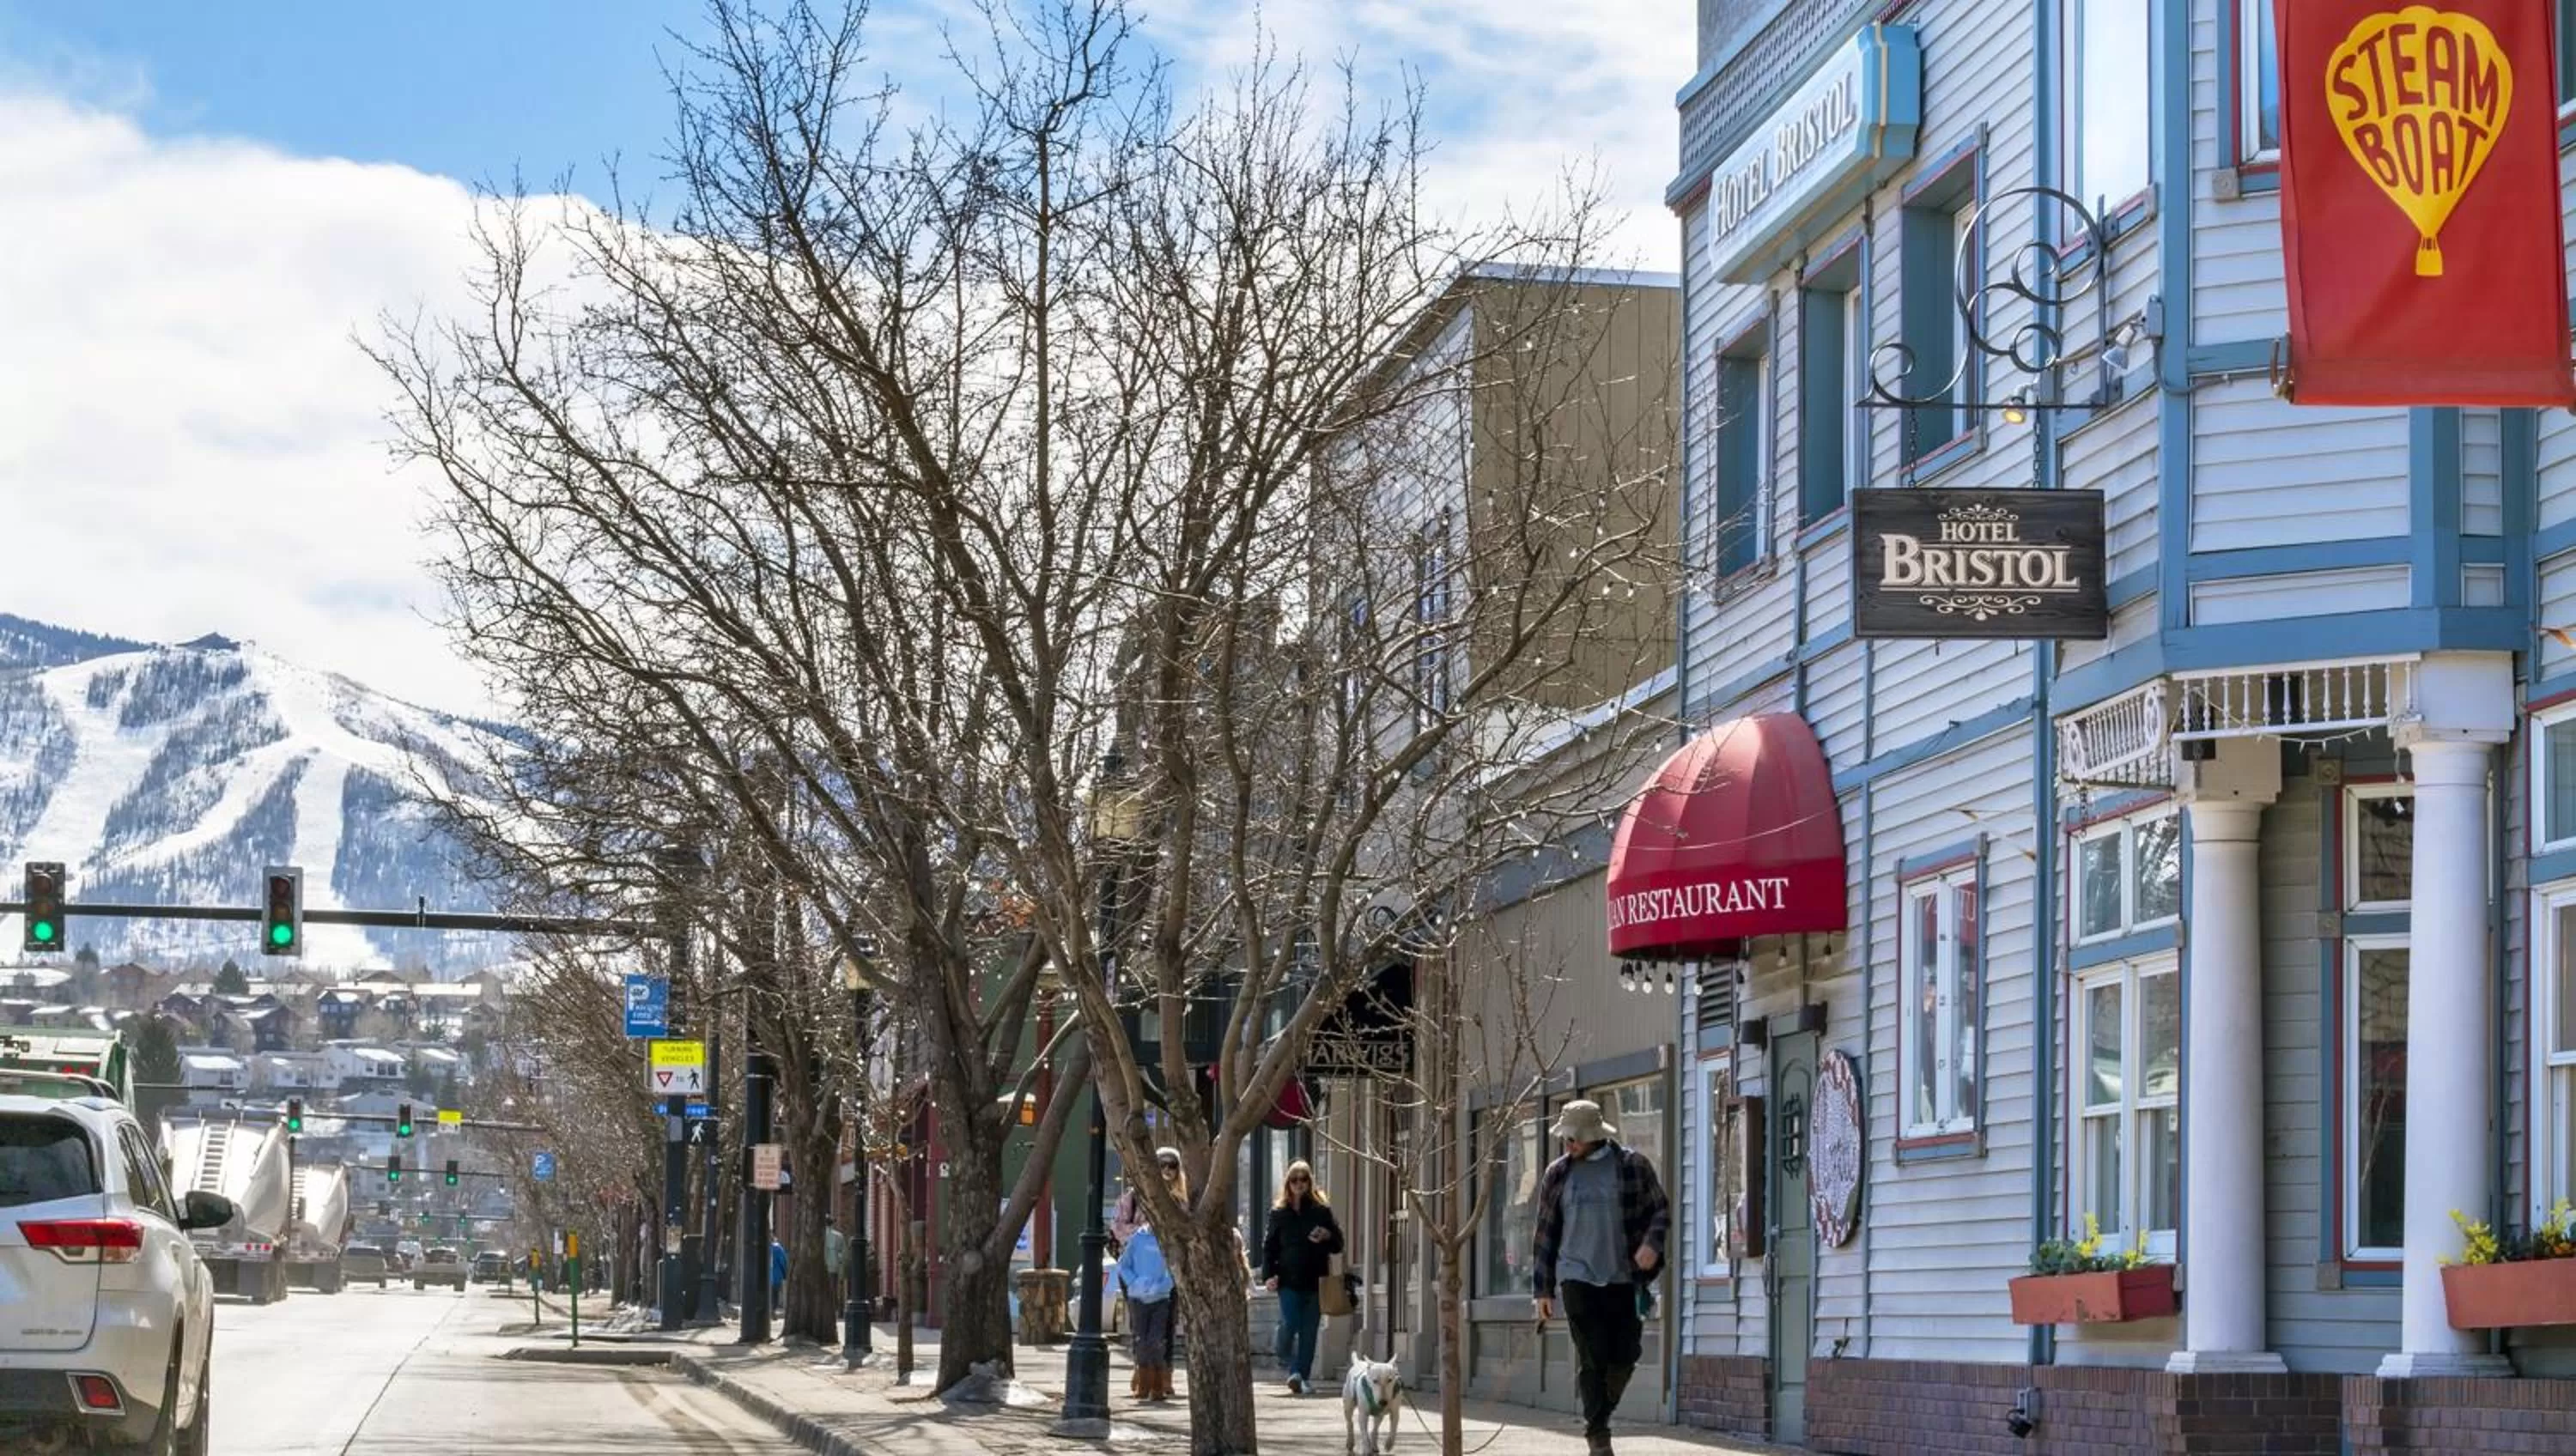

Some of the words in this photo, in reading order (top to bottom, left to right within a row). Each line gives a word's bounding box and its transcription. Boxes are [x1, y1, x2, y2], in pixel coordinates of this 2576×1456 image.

[2333, 23, 2499, 127] STEAM
[1715, 148, 1773, 246] HOTEL
[1773, 71, 1857, 191] BRISTOL
[2353, 111, 2488, 196] BOAT
[1878, 533, 2081, 588] BRISTOL
[1940, 521, 2020, 543] HOTEL
[1627, 877, 1789, 925] RESTAURANT
